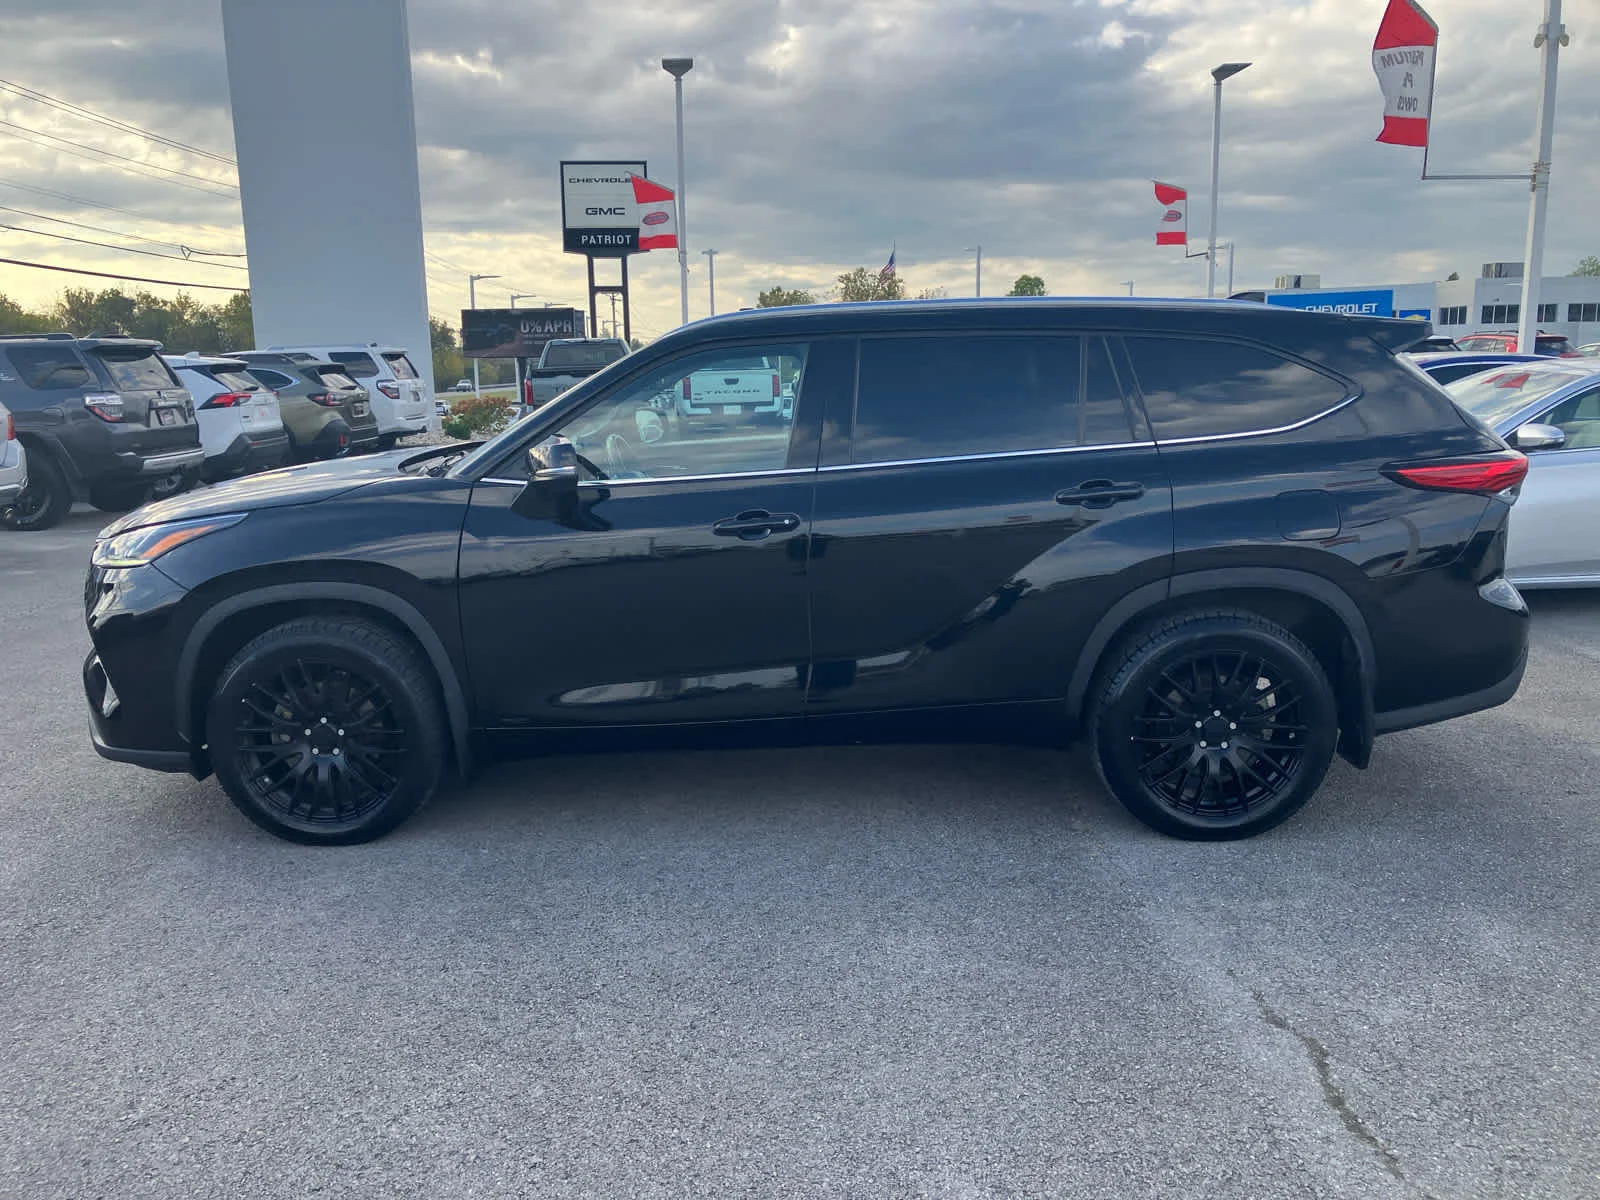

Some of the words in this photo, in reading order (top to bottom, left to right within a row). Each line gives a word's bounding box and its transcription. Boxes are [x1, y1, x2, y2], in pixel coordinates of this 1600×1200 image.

[585, 207, 625, 215] GMC
[581, 235, 632, 245] PATRIOT
[1305, 303, 1380, 314] CHEVROLET
